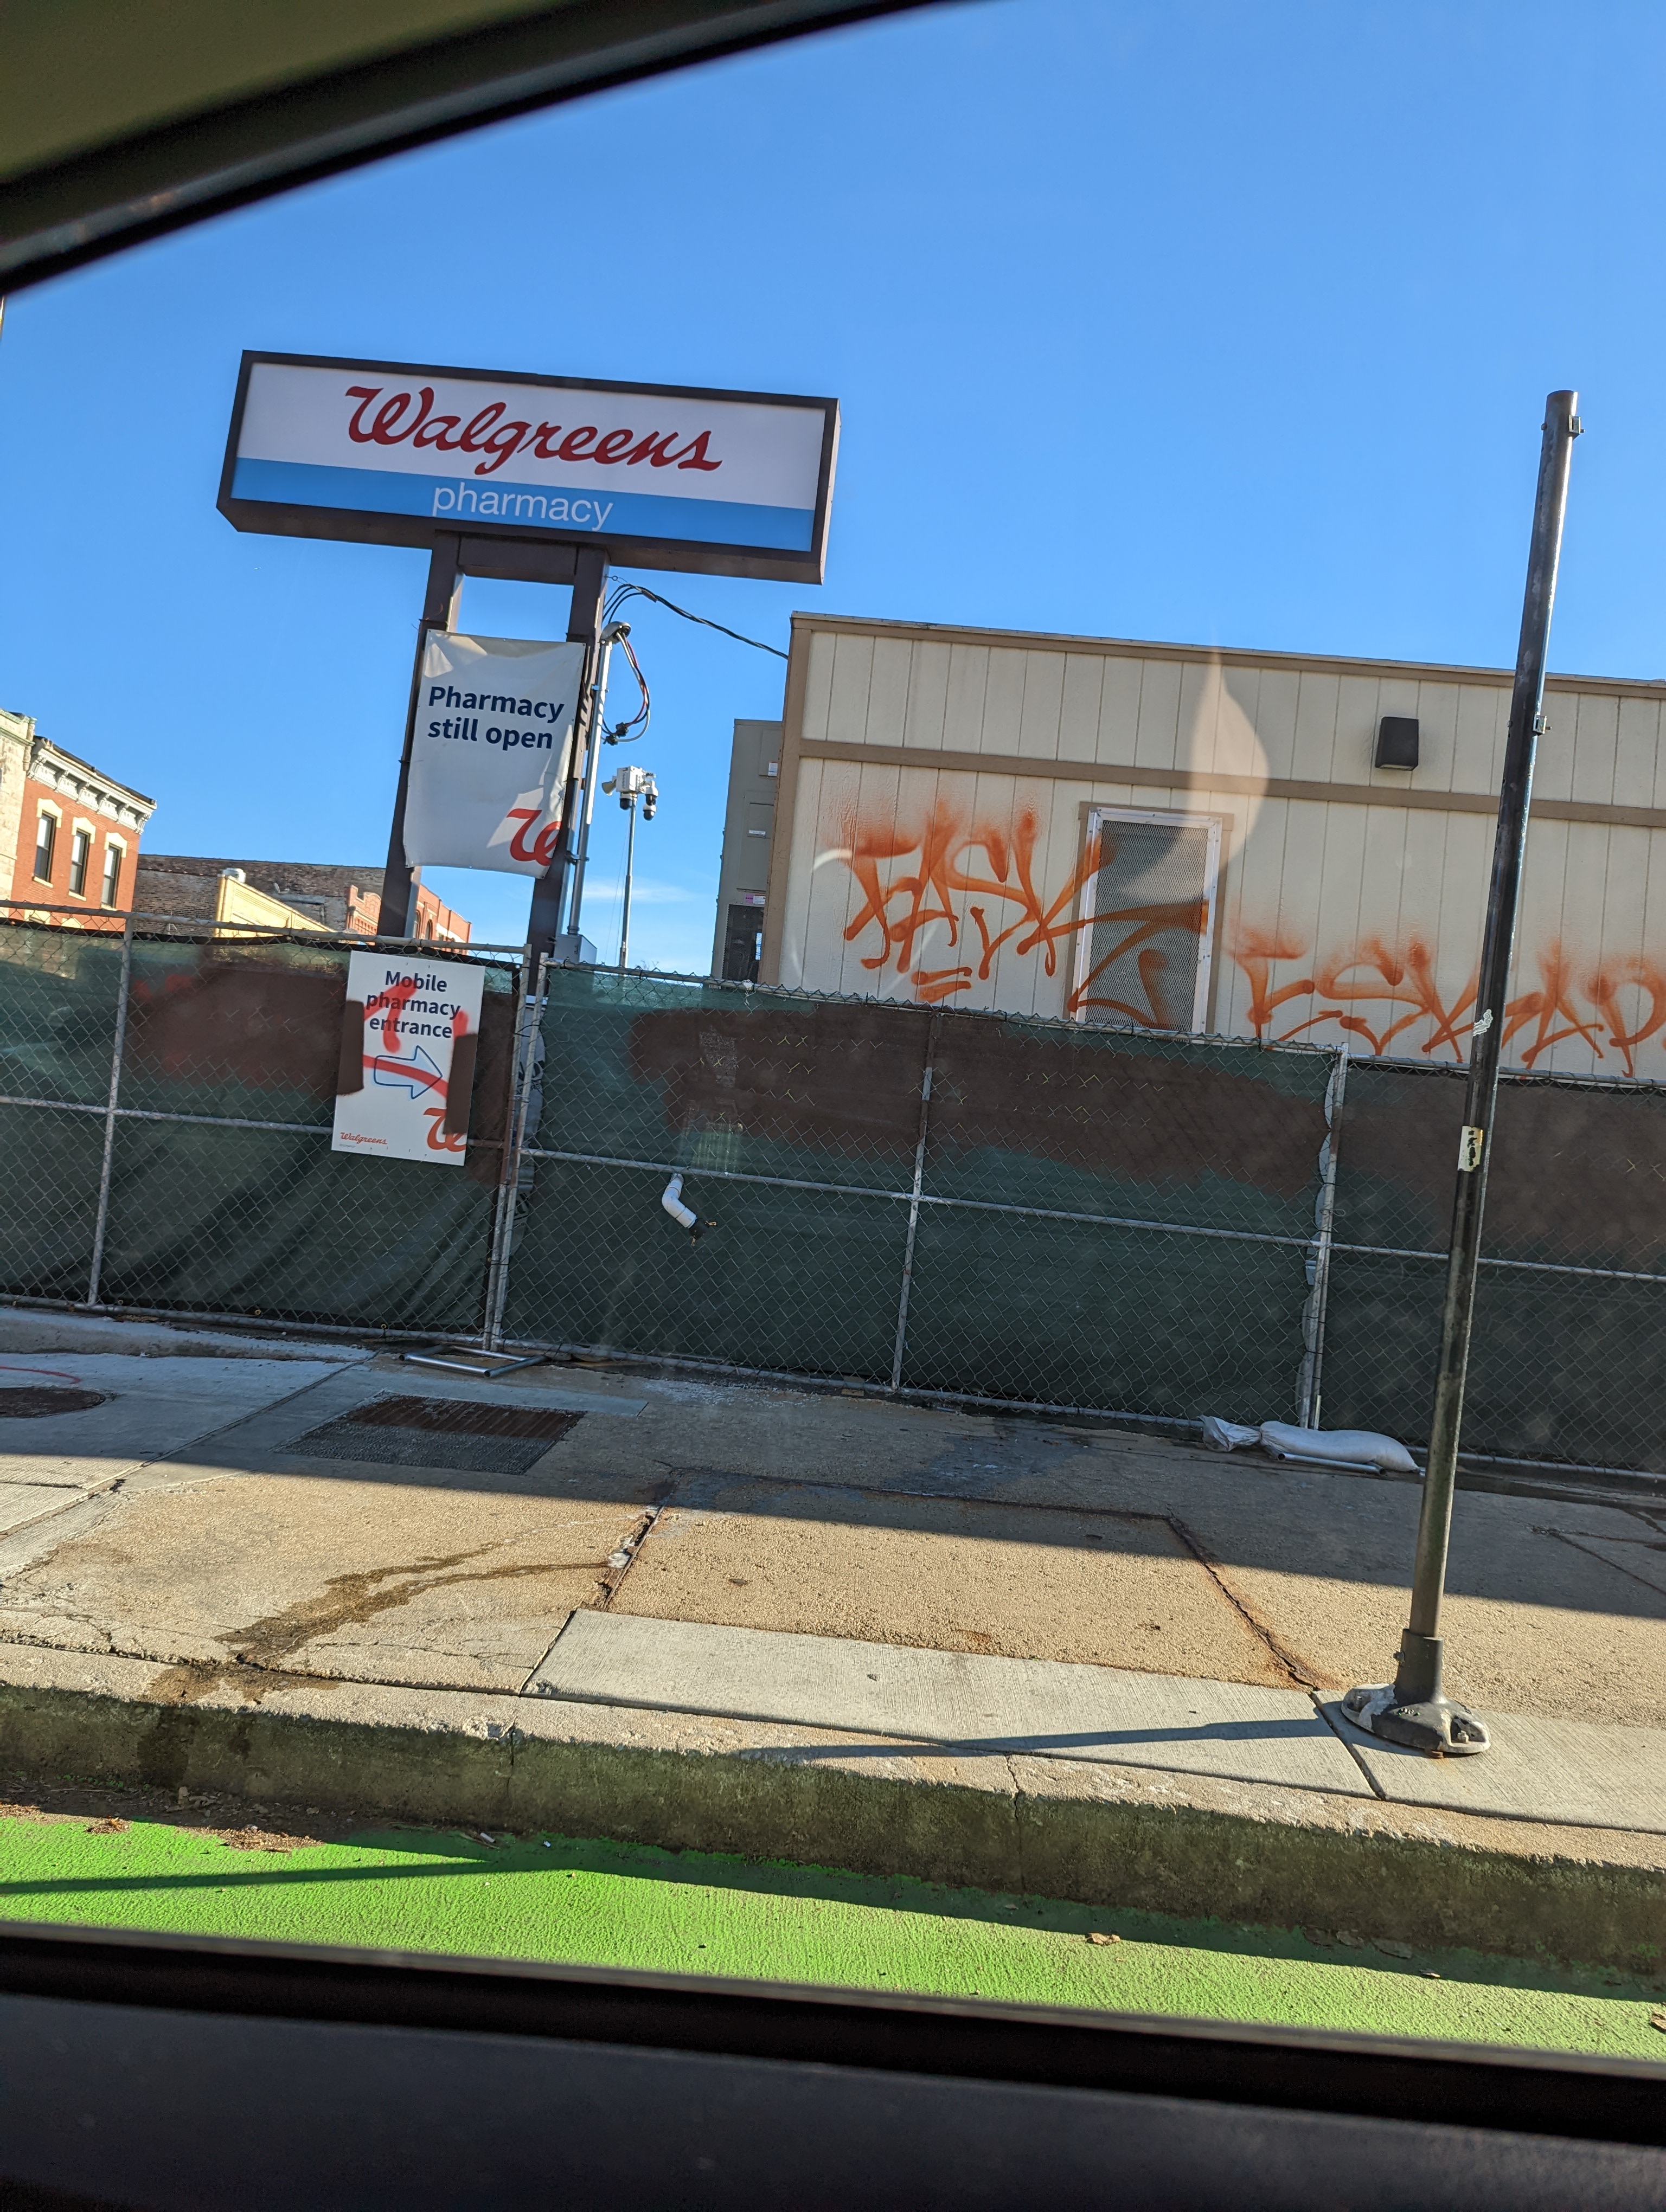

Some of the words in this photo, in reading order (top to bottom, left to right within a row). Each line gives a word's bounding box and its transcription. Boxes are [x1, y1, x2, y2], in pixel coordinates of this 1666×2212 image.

[345, 386, 722, 475] Walgreens
[433, 481, 613, 532] pharmacy
[428, 685, 565, 724] Pharmacy
[427, 717, 478, 742] still
[485, 725, 553, 751] open
[385, 970, 447, 992] Mobile
[366, 992, 462, 1020] pharmacy
[369, 1018, 453, 1039] entrance
[340, 1132, 388, 1144] Walgreens
